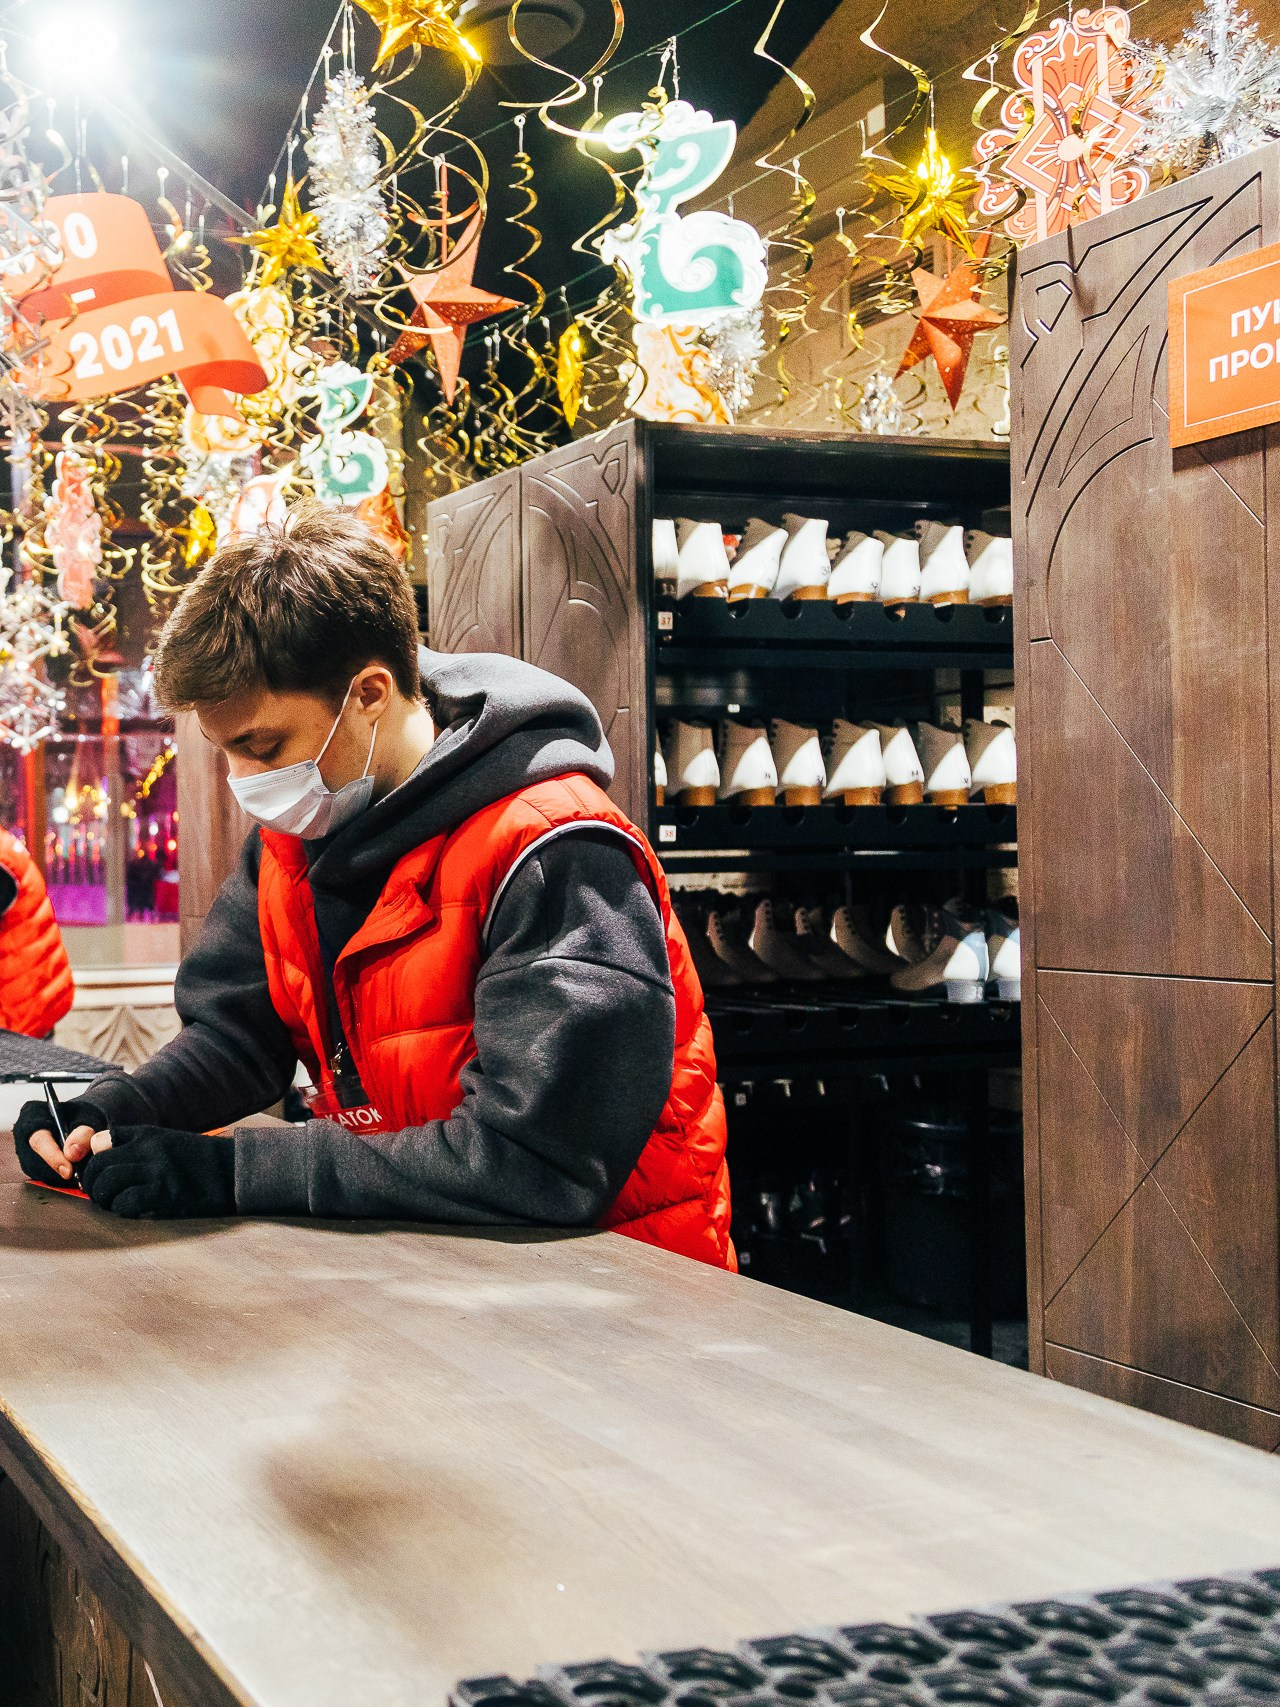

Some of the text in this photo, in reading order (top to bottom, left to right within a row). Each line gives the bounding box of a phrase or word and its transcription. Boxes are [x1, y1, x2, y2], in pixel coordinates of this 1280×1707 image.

[69, 309, 185, 379] 2021
[1209, 338, 1280, 383] ПРО
[661, 616, 672, 626] 37
